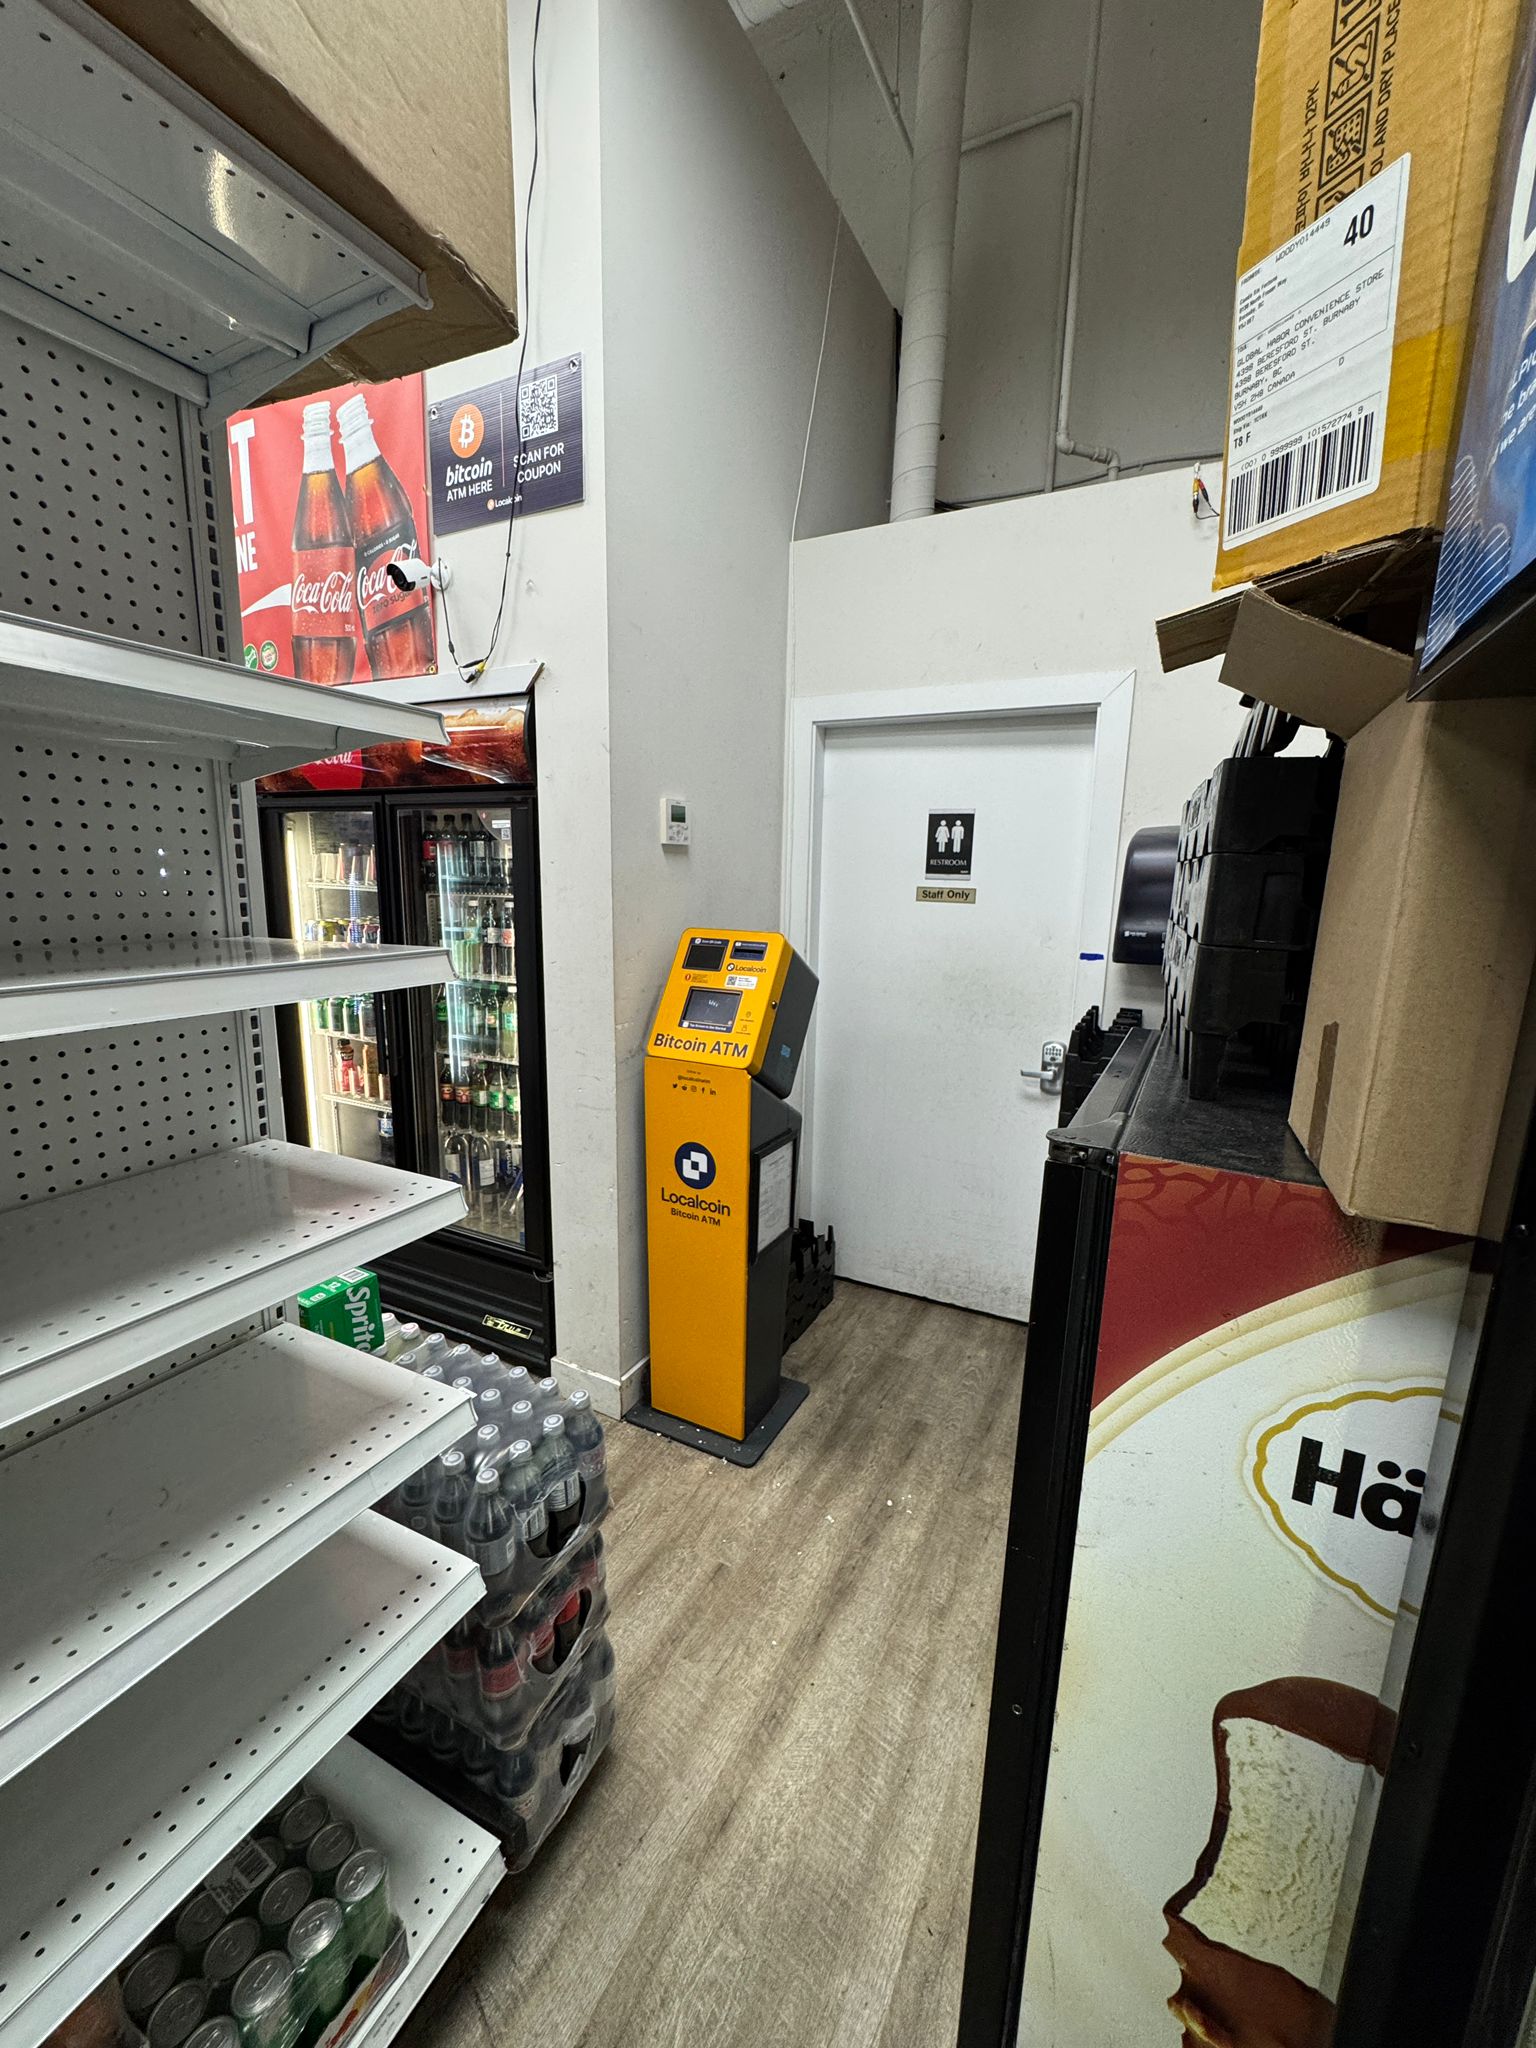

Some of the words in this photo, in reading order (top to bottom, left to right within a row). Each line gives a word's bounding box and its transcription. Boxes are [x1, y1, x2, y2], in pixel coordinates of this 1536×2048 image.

[1382, 0, 1401, 67] PLACE
[1378, 64, 1395, 109] DRY
[1305, 80, 1320, 127] 12PK
[1373, 105, 1390, 151] AND
[1299, 124, 1318, 182] 바나나
[1370, 147, 1384, 178] OL
[1343, 204, 1374, 247] 40
[1236, 348, 1263, 367] GLOBAL
[1266, 328, 1290, 349] HABOR
[1294, 290, 1350, 332] CONVENIENCE
[1355, 268, 1385, 293] STORE
[1257, 335, 1299, 367] BERESFORD
[1303, 326, 1318, 339] ST.
[1323, 296, 1361, 327] BURNABY
[1255, 349, 1297, 379] BERESFORD
[1300, 338, 1316, 351] ST.
[1272, 367, 1283, 379] BC
[1338, 356, 1345, 367] D
[1267, 371, 1296, 392] CANADA
[1307, 411, 1353, 440] 101572774
[1357, 405, 1364, 415] 9
[513, 448, 541, 468] SCAN
[544, 442, 565, 460] FOR
[1233, 437, 1243, 449] T8
[1245, 431, 1251, 444] F
[229, 418, 255, 527] T
[446, 456, 493, 487] bitcoin
[517, 460, 561, 484] COUPON
[446, 485, 466, 502] ATM
[468, 480, 493, 496] HERE
[921, 890, 944, 899] Staff
[947, 889, 970, 901] Only
[735, 965, 766, 973] Localcoin
[654, 1033, 707, 1052] Bitcoin
[710, 1040, 749, 1058] ATM
[661, 1187, 731, 1216] Localcoin
[670, 1207, 699, 1221] Bitcoin
[701, 1215, 721, 1227] ATM
[1291, 1436, 1427, 1538] Hä
